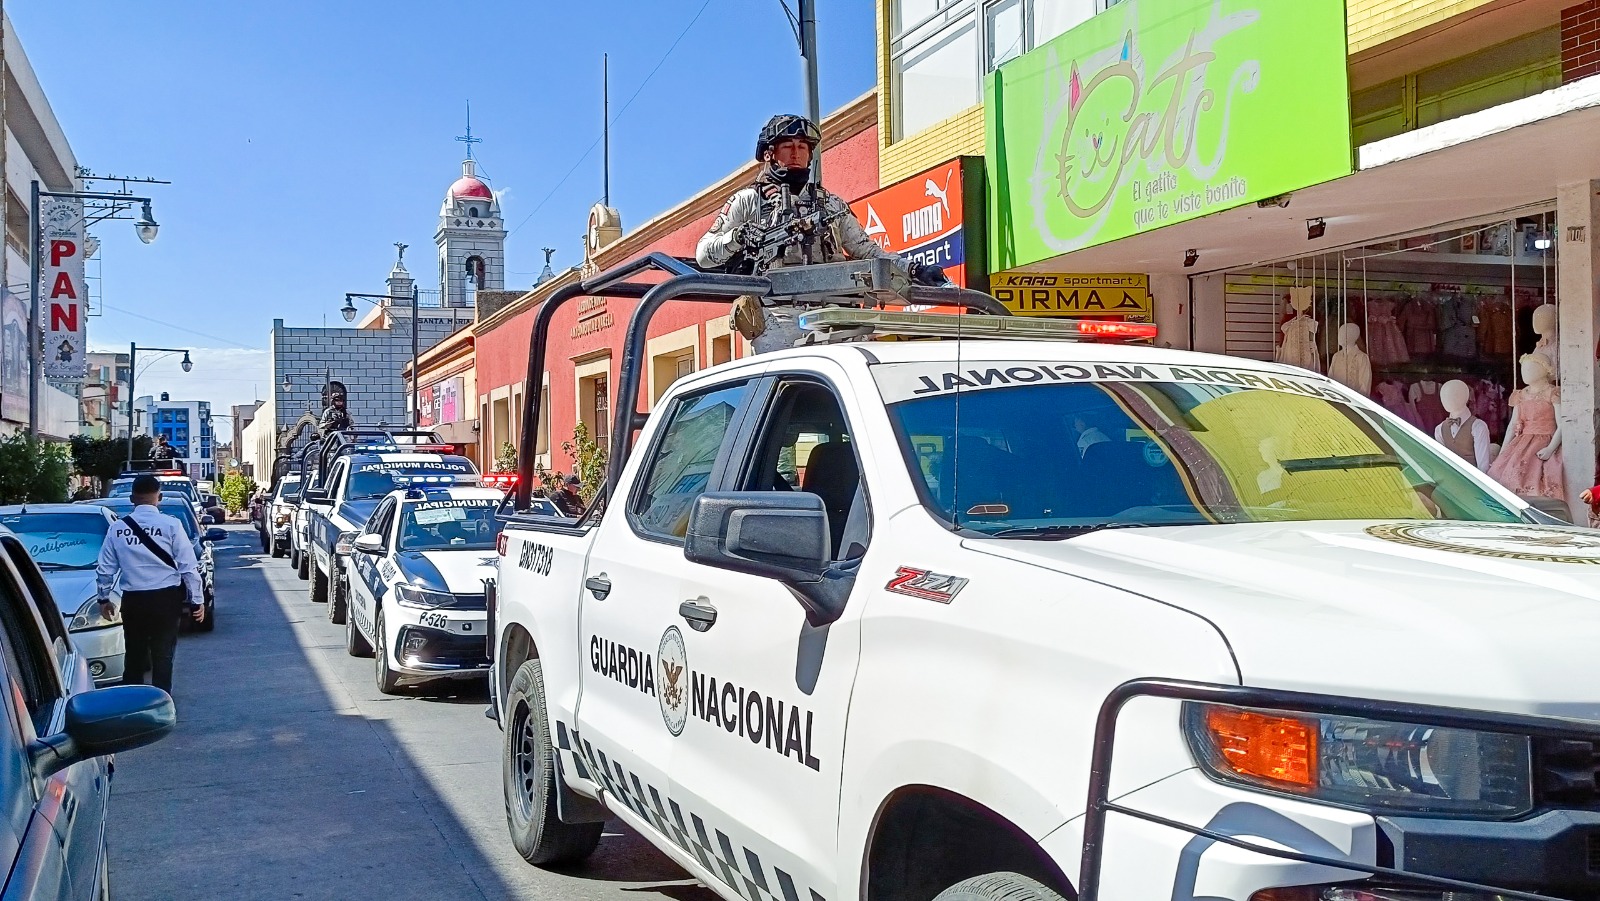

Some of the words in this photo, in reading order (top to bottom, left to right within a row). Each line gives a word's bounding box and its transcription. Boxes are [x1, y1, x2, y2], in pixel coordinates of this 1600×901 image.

[1133, 180, 1141, 201] El
[1145, 171, 1177, 202] gatito
[1133, 206, 1155, 230] que
[1157, 200, 1169, 220] te
[1173, 191, 1202, 214] viste
[1206, 175, 1246, 206] bonito
[903, 201, 943, 243] PUMA
[50, 239, 78, 332] PAN
[1063, 276, 1133, 287] sportmart
[995, 289, 1106, 310] PIRMA
[116, 526, 162, 538] POCÍA
[30, 539, 87, 557] California
[884, 565, 970, 605] Z71
[419, 611, 448, 629] P-526
[590, 634, 656, 698] GUARDIA
[692, 670, 821, 773] NACIONAL
